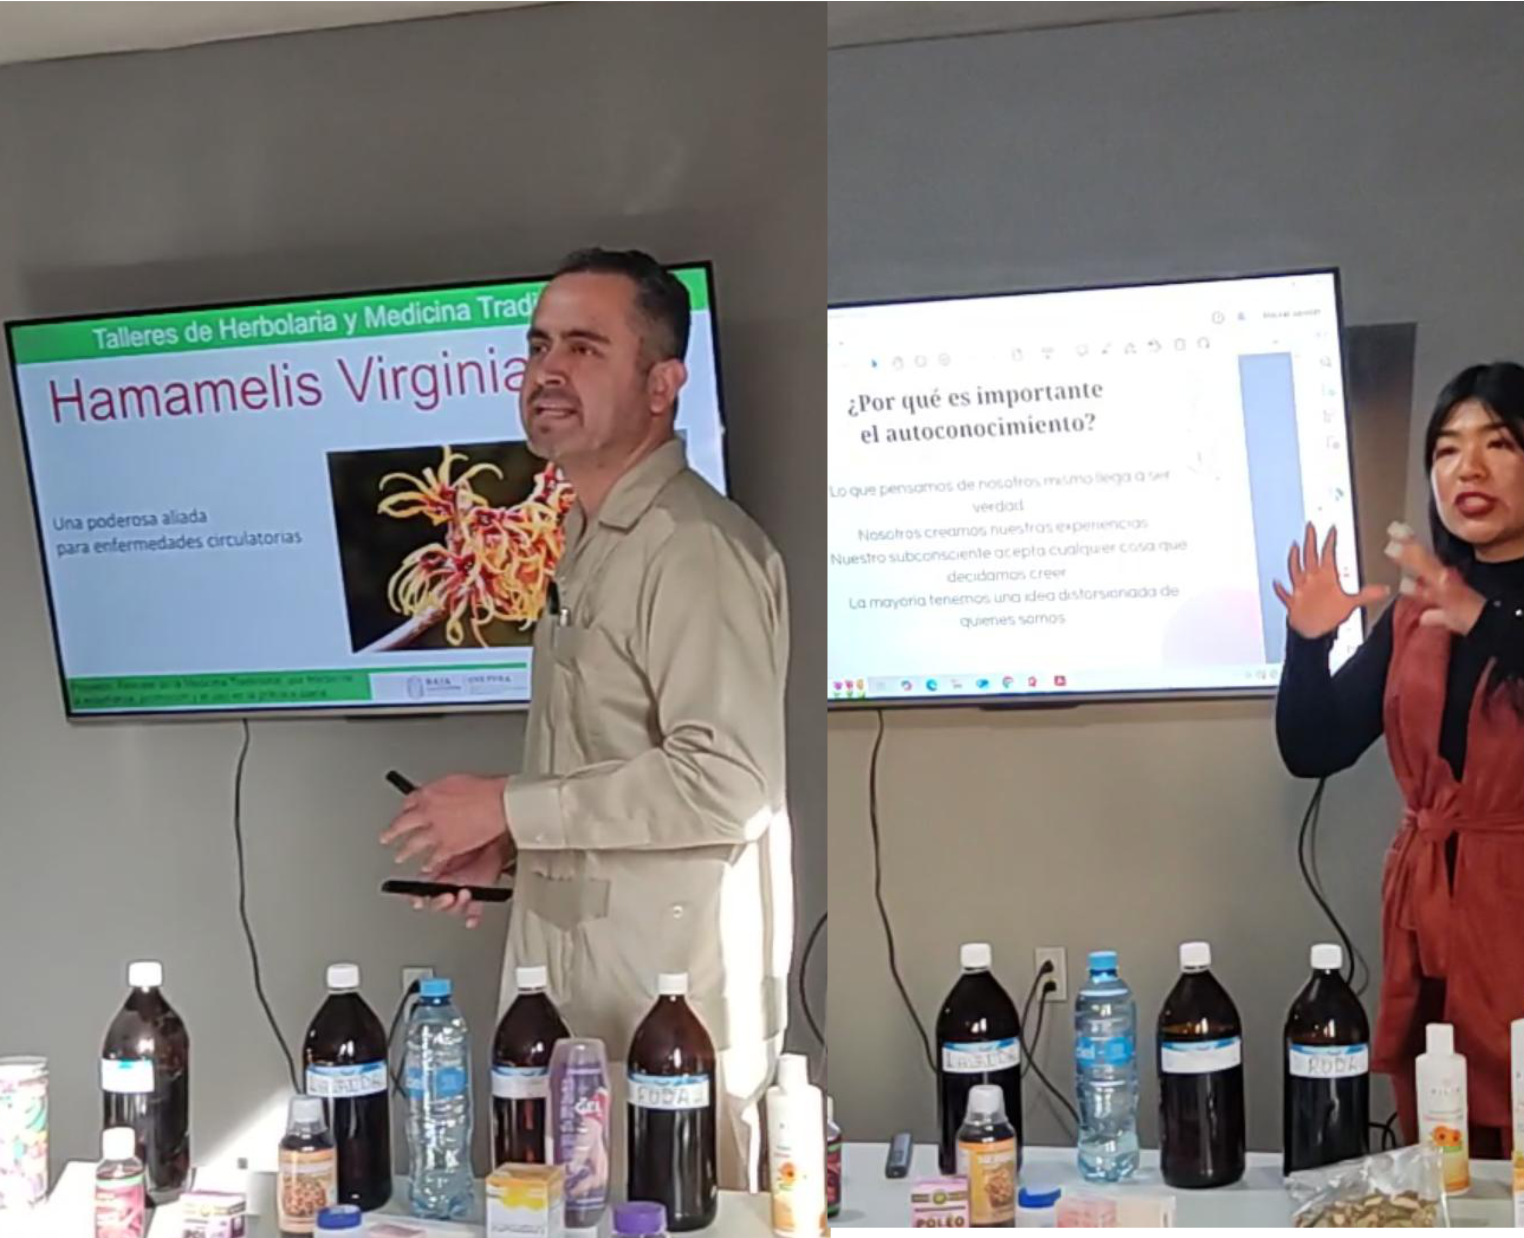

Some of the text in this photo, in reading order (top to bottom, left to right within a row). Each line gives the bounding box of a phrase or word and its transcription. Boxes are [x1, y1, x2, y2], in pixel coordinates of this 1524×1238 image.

[93, 325, 178, 350] Talleres
[184, 321, 213, 343] de
[219, 310, 338, 340] Herbolaria
[343, 313, 357, 336] y
[364, 301, 471, 329] Medicina
[49, 347, 527, 424] Hamamelis Virginia
[848, 382, 1104, 417] ¿Por qué es importante
[860, 412, 1096, 444] el autoconocimiento?
[849, 484, 876, 499] que
[52, 508, 208, 532] Una poderosa aliada
[56, 530, 303, 558] para enfermedades circulatorias
[830, 552, 887, 566] Nuestro
